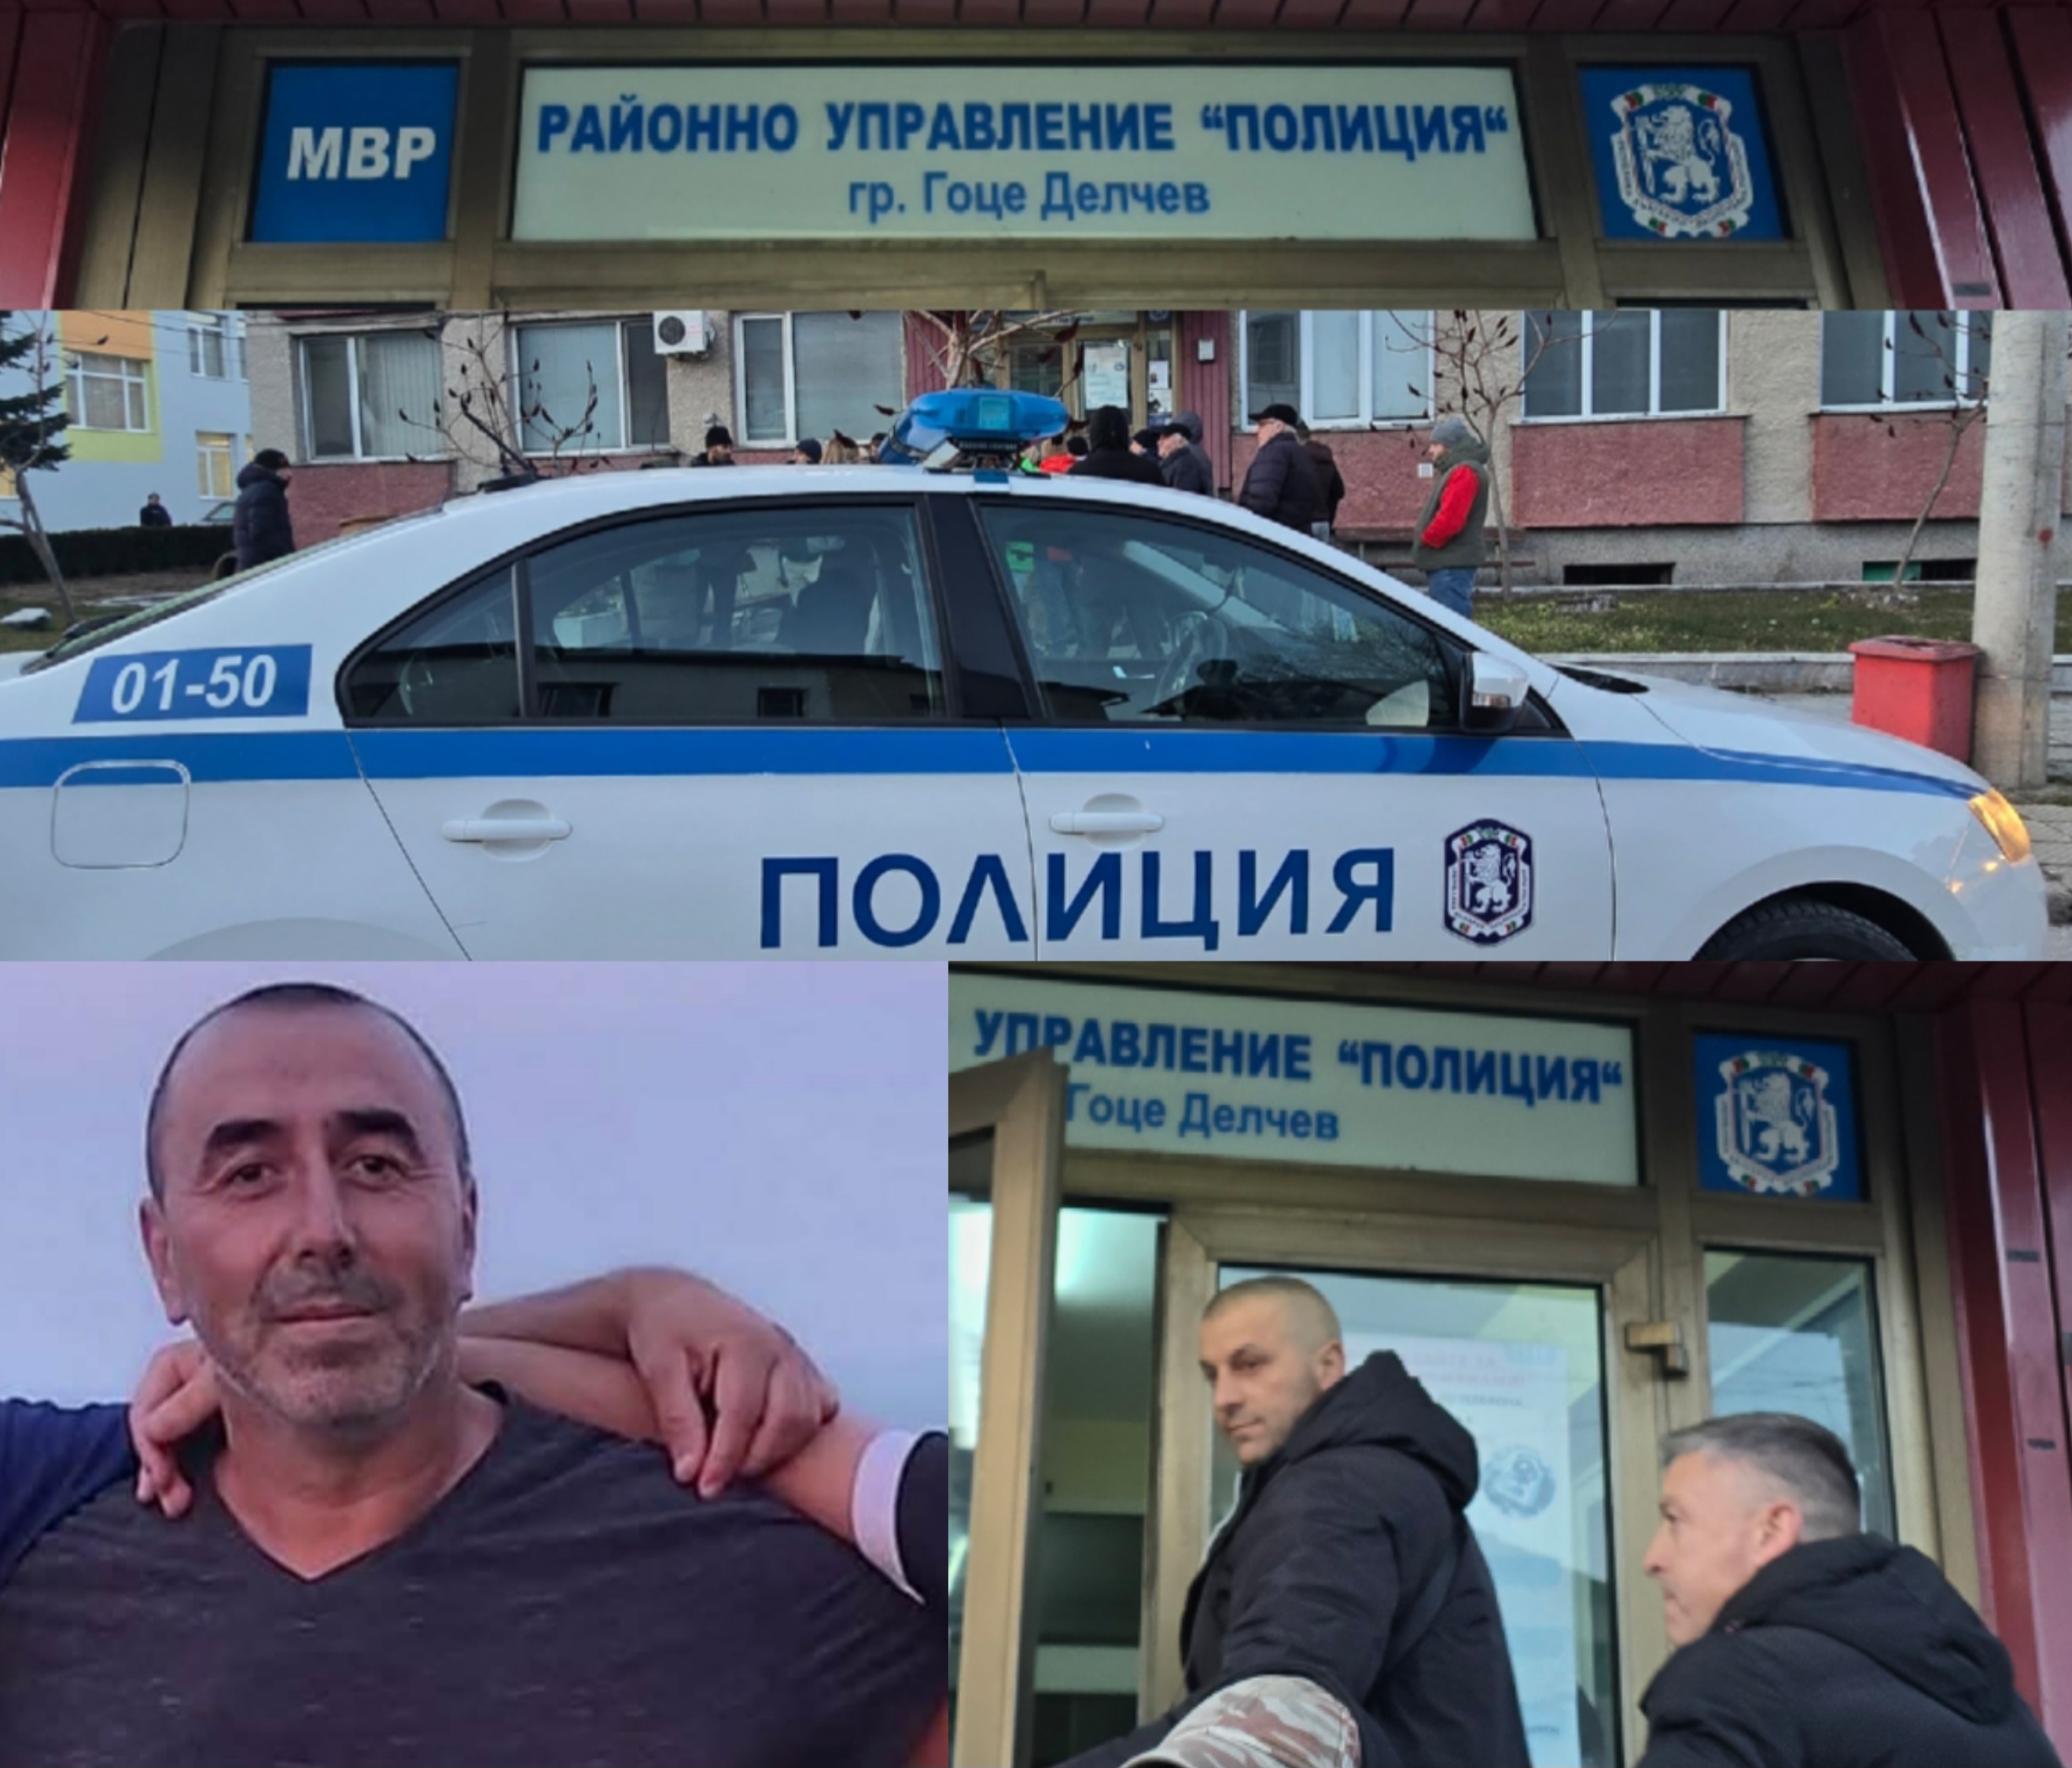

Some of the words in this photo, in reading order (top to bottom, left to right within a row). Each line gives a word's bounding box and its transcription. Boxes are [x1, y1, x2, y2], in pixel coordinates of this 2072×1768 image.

[286, 127, 436, 180] МВР
[538, 94, 799, 154] РАЙОННО
[826, 102, 1176, 152] УПРАВЛЕНИЕ
[848, 182, 906, 225] гр.
[922, 171, 1027, 221] Гоце
[1039, 171, 1212, 222] Делчев
[112, 654, 277, 714] 01-50
[760, 847, 1395, 951] ПОЛИЦИЯ
[974, 1009, 1312, 1081] УПРАВЛЕНИЕ
[1066, 1081, 1168, 1133] Гоце
[1178, 1091, 1341, 1141] Делчев
